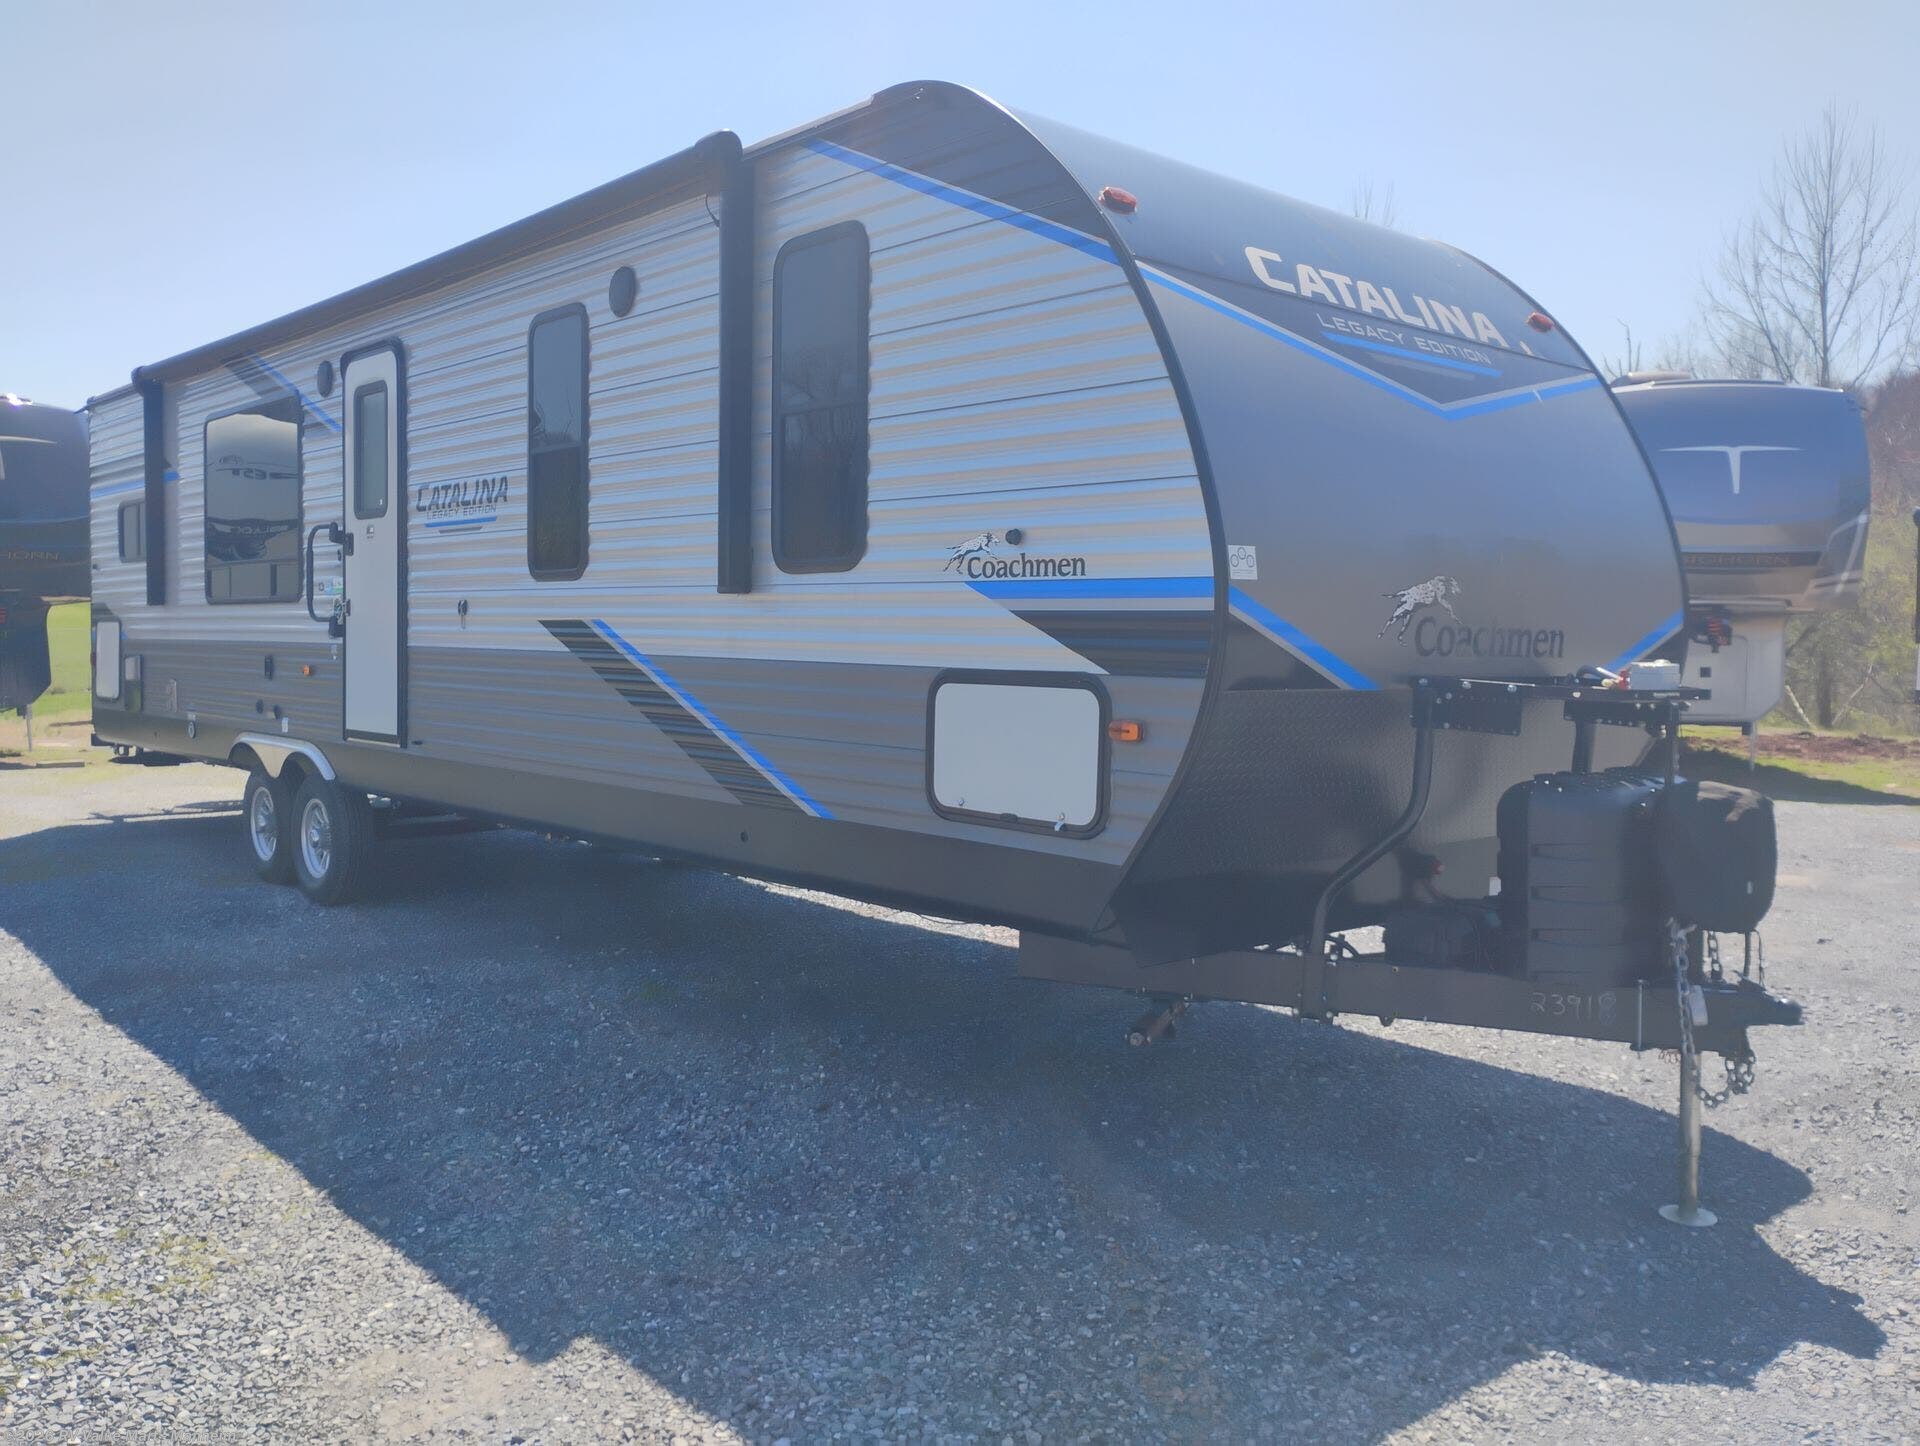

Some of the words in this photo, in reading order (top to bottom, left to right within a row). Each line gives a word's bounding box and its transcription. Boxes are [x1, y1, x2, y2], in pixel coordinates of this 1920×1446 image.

[1244, 246, 1509, 348] CATALINA
[1316, 313, 1404, 345] LEGACY
[1413, 336, 1493, 365] EDITION
[416, 476, 509, 512] CATALINA
[426, 507, 458, 520] LEGACY
[463, 504, 497, 516] EDITION
[967, 553, 1086, 579] Coachmen
[1414, 615, 1565, 658] Coachmen
